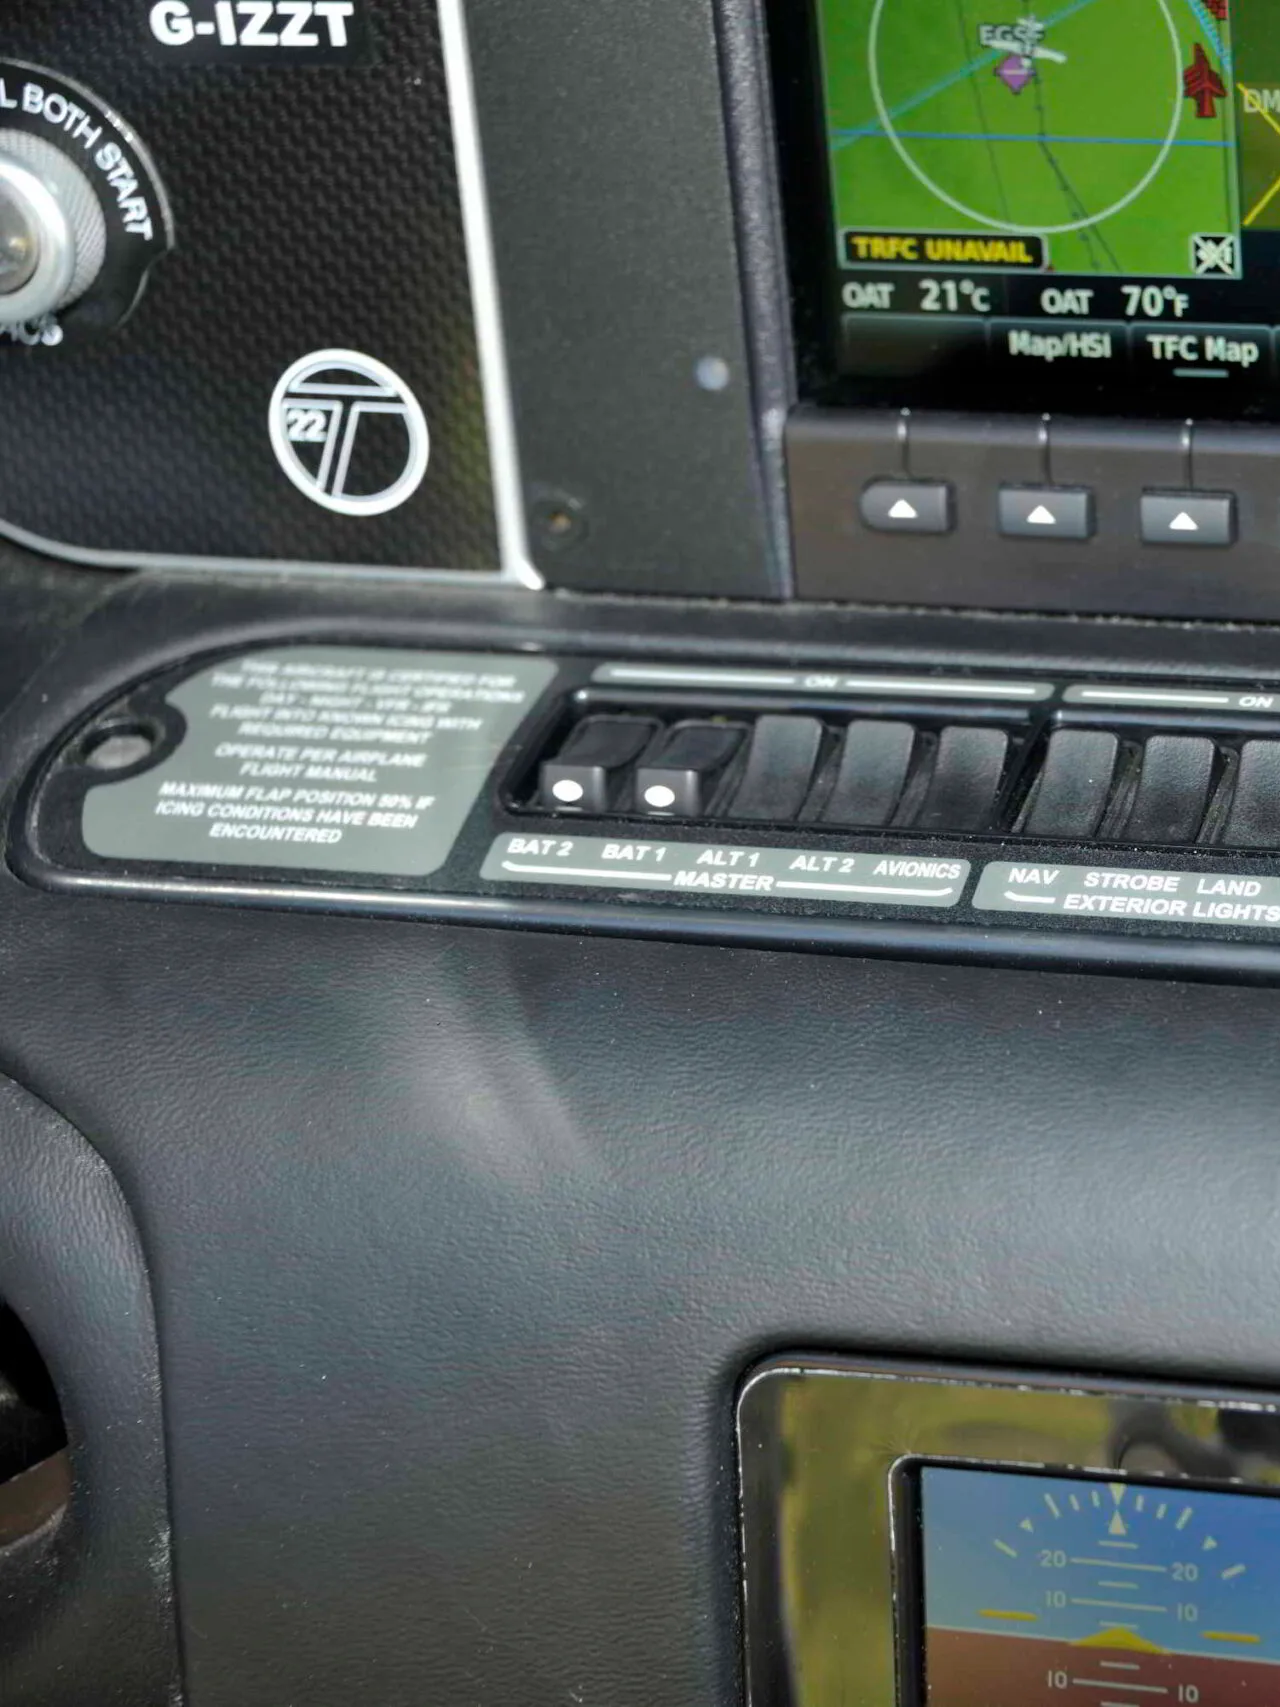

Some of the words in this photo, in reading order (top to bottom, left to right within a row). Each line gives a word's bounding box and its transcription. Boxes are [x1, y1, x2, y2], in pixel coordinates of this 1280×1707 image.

[149, 0, 354, 46] G-IZZT
[22, 82, 102, 149] BOTH
[95, 142, 153, 241] START
[851, 237, 918, 260] TRFC
[926, 239, 1034, 264] UNAVAIL
[842, 283, 895, 308] OAT
[1041, 289, 1094, 314] OAT
[1008, 330, 1112, 361] Map/HSI
[1147, 335, 1199, 361] TFC
[1204, 338, 1259, 366] Map
[804, 674, 839, 689] ON
[1238, 694, 1274, 709] ON
[214, 741, 299, 761] OPERATE
[299, 745, 339, 763] PER
[338, 749, 428, 768] AIRPLANE
[239, 760, 305, 778] FLIGHT
[304, 764, 377, 783] MANUAL
[158, 781, 245, 801] MAXIMUM
[244, 785, 293, 803] FLAP
[292, 788, 377, 808] POSITION
[154, 799, 206, 819] ICING
[206, 802, 315, 823] CONDITIONS
[314, 807, 368, 826] HAVE
[366, 810, 419, 829] BEEN
[208, 821, 343, 845] ENCOUNTERED
[507, 837, 558, 857] BAT
[557, 841, 574, 858] 2
[602, 844, 651, 862] BAT
[652, 847, 667, 864] 1
[697, 849, 744, 868] ALT
[745, 852, 760, 868] 1
[789, 855, 837, 873] ALT
[838, 858, 856, 874] 2
[873, 859, 961, 881] AVIONICS
[674, 869, 777, 892] MASTER
[1008, 867, 1061, 886] NAV
[1084, 872, 1181, 893] STROBE
[1196, 877, 1262, 898] LAND
[1063, 893, 1191, 918] EXTERIOR
[1040, 1548, 1068, 1570] 20
[1171, 1562, 1199, 1583] 20
[1045, 1590, 1067, 1609] 10
[1175, 1604, 1199, 1623] 10
[1046, 1671, 1068, 1690] 10
[1176, 1684, 1200, 1705] 10
